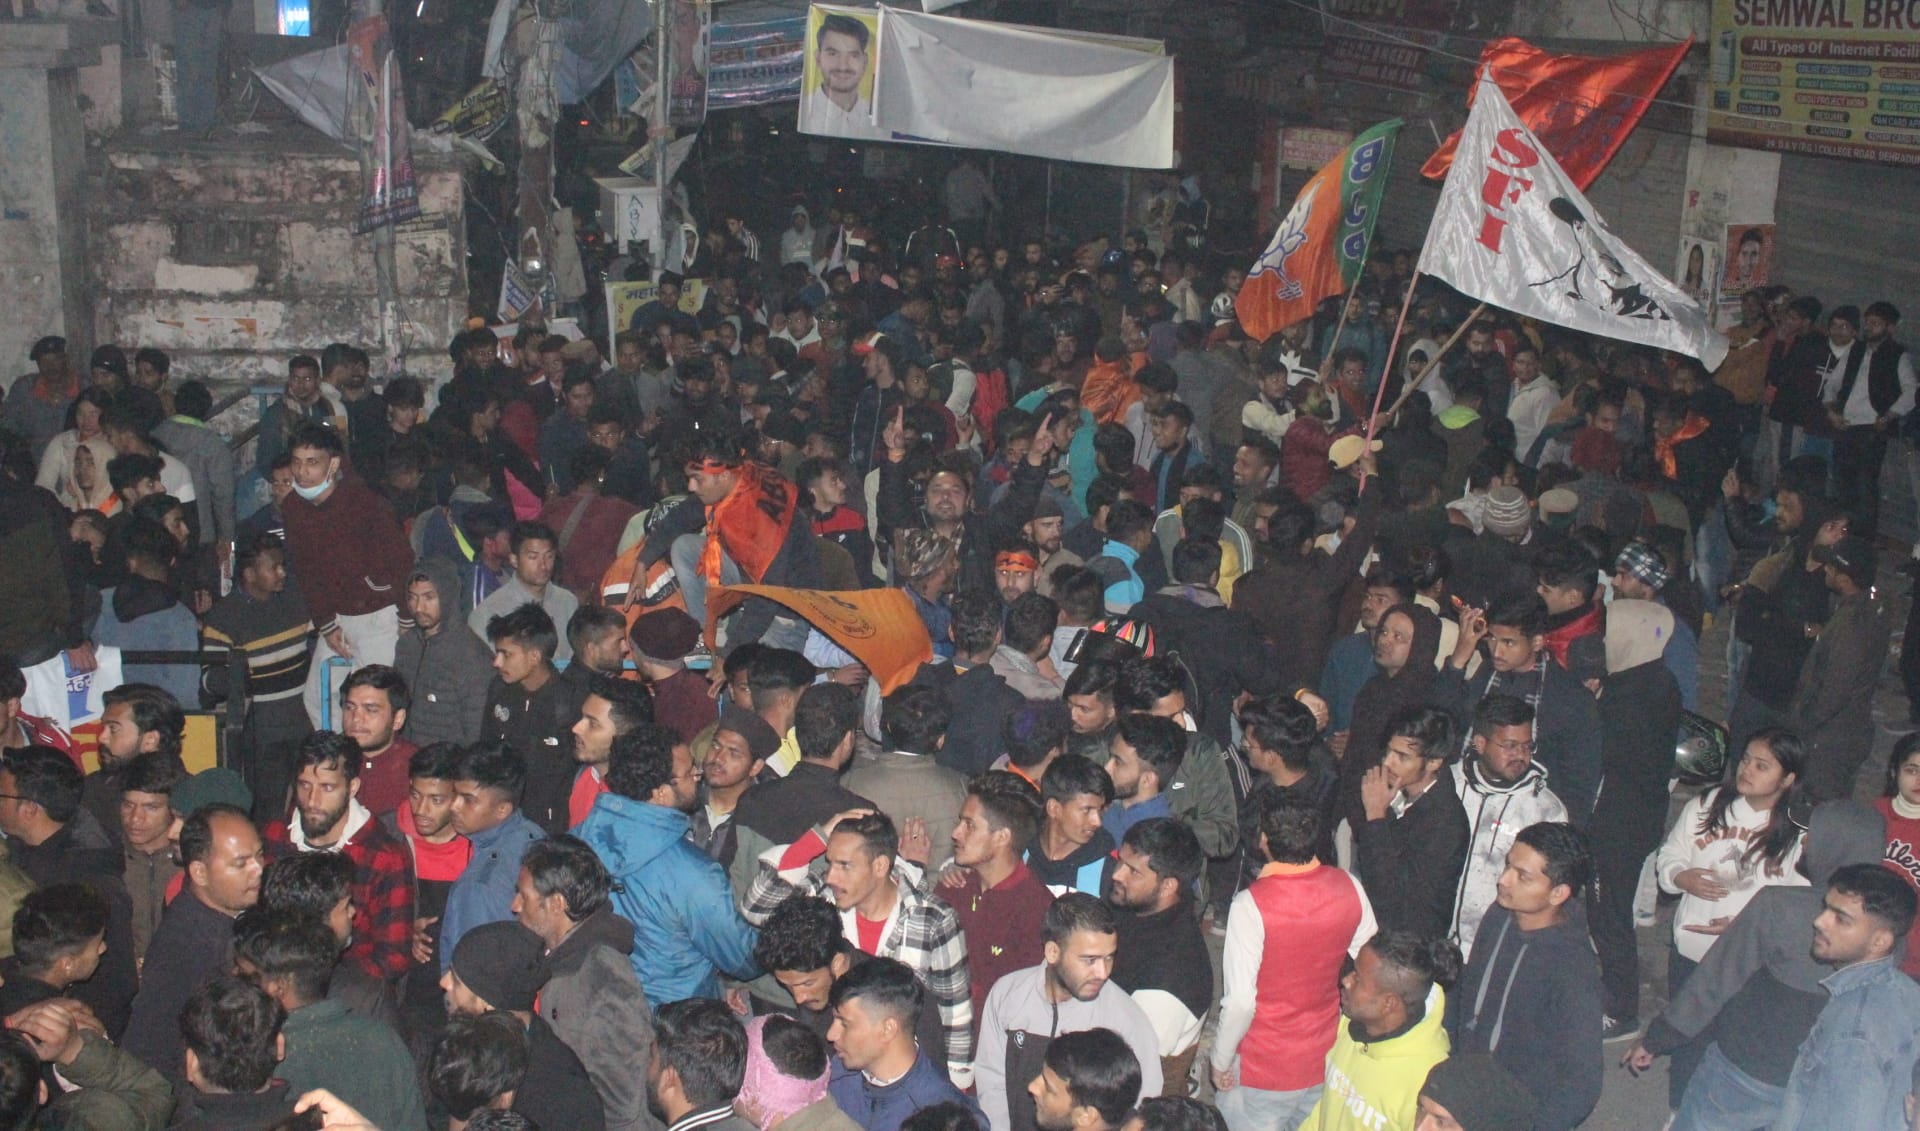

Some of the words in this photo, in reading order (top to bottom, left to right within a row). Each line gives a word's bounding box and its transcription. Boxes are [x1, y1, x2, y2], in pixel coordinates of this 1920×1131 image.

[1734, 0, 1854, 29] SEMWAL
[1752, 39, 1768, 52] All
[1770, 40, 1805, 55] Types
[1808, 42, 1823, 54] Of
[1829, 43, 1881, 57] Internet
[1818, 144, 1852, 158] COLLEGE
[1477, 128, 1540, 255] SFI
